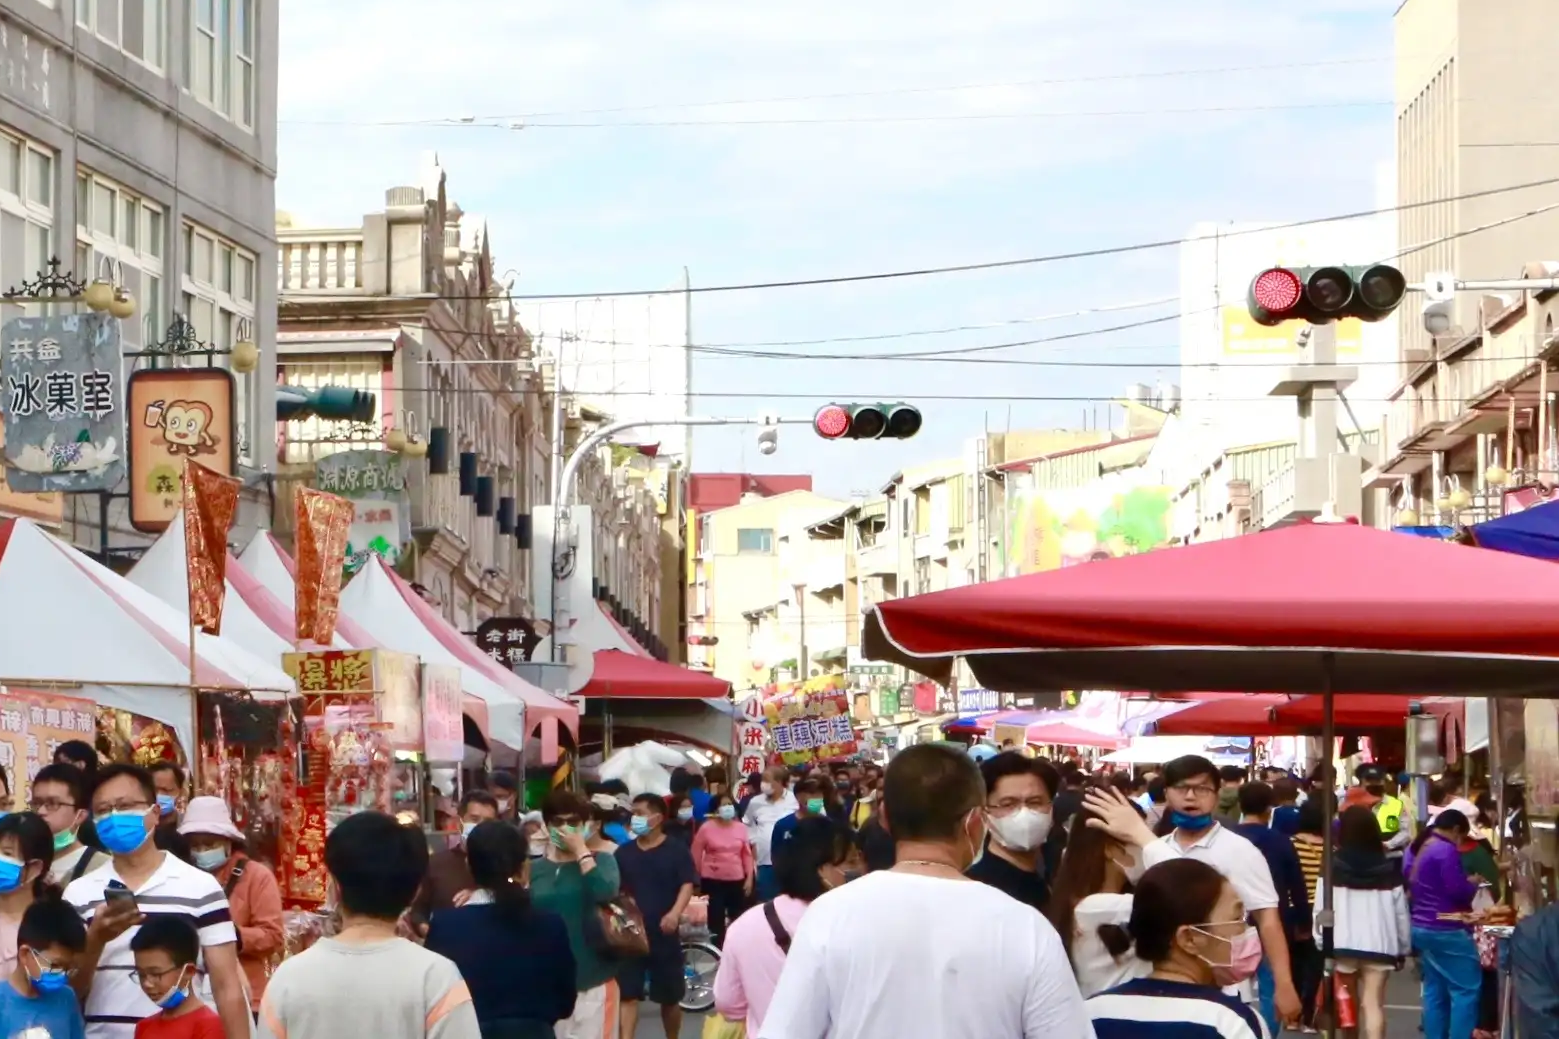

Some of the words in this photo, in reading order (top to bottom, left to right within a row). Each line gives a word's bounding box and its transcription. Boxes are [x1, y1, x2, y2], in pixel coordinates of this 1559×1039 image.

[7, 369, 114, 415] 冰菓室
[486, 627, 527, 644] 老街
[773, 715, 854, 752] 蓮藕涼糕
